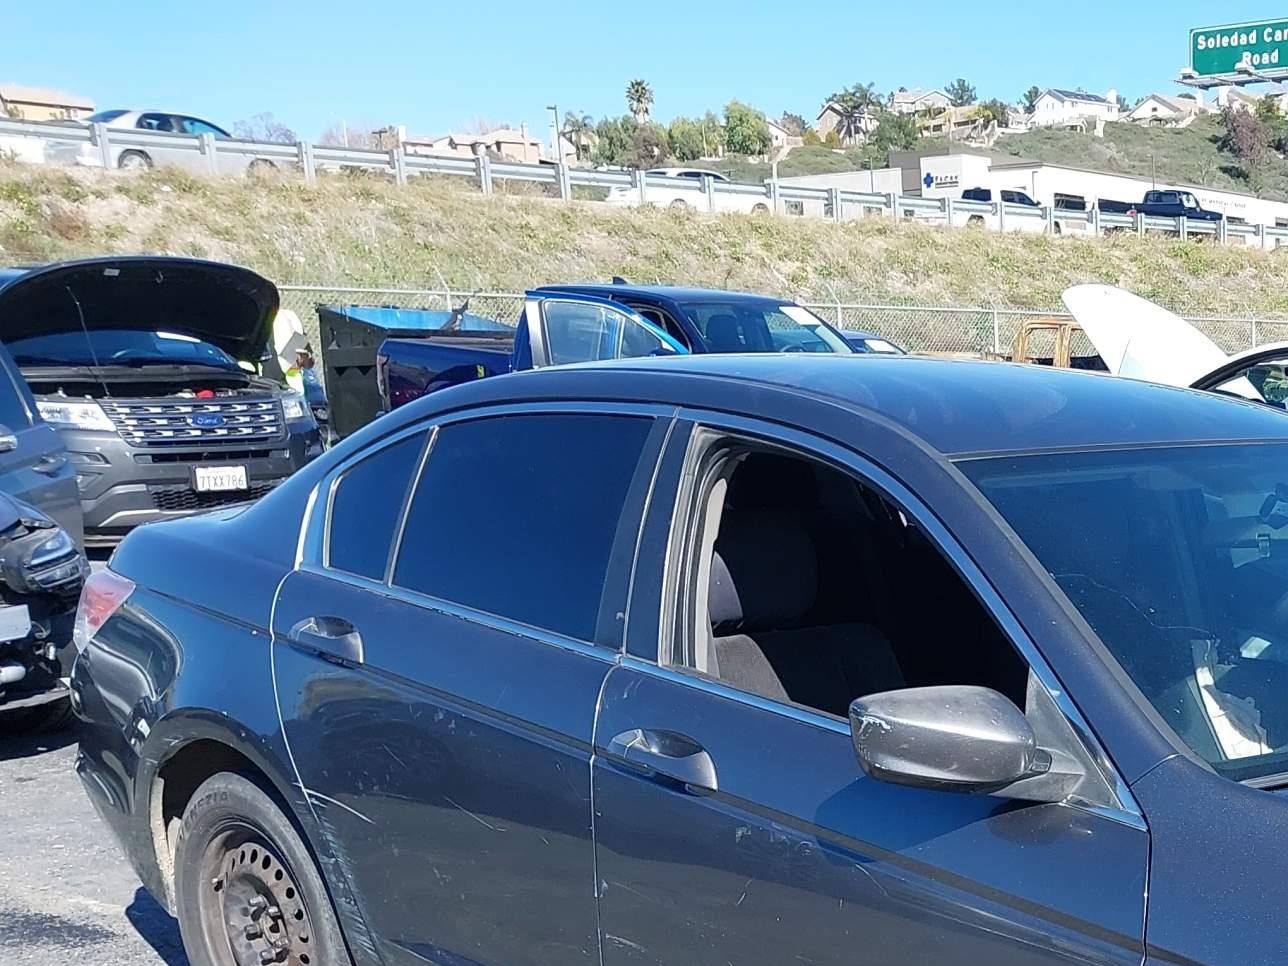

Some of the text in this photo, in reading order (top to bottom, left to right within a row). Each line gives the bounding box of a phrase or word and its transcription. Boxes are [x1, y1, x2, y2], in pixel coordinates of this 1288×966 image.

[1197, 30, 1257, 50] Soledad
[1242, 48, 1280, 66] Road
[199, 474, 244, 489] 7TXX786
